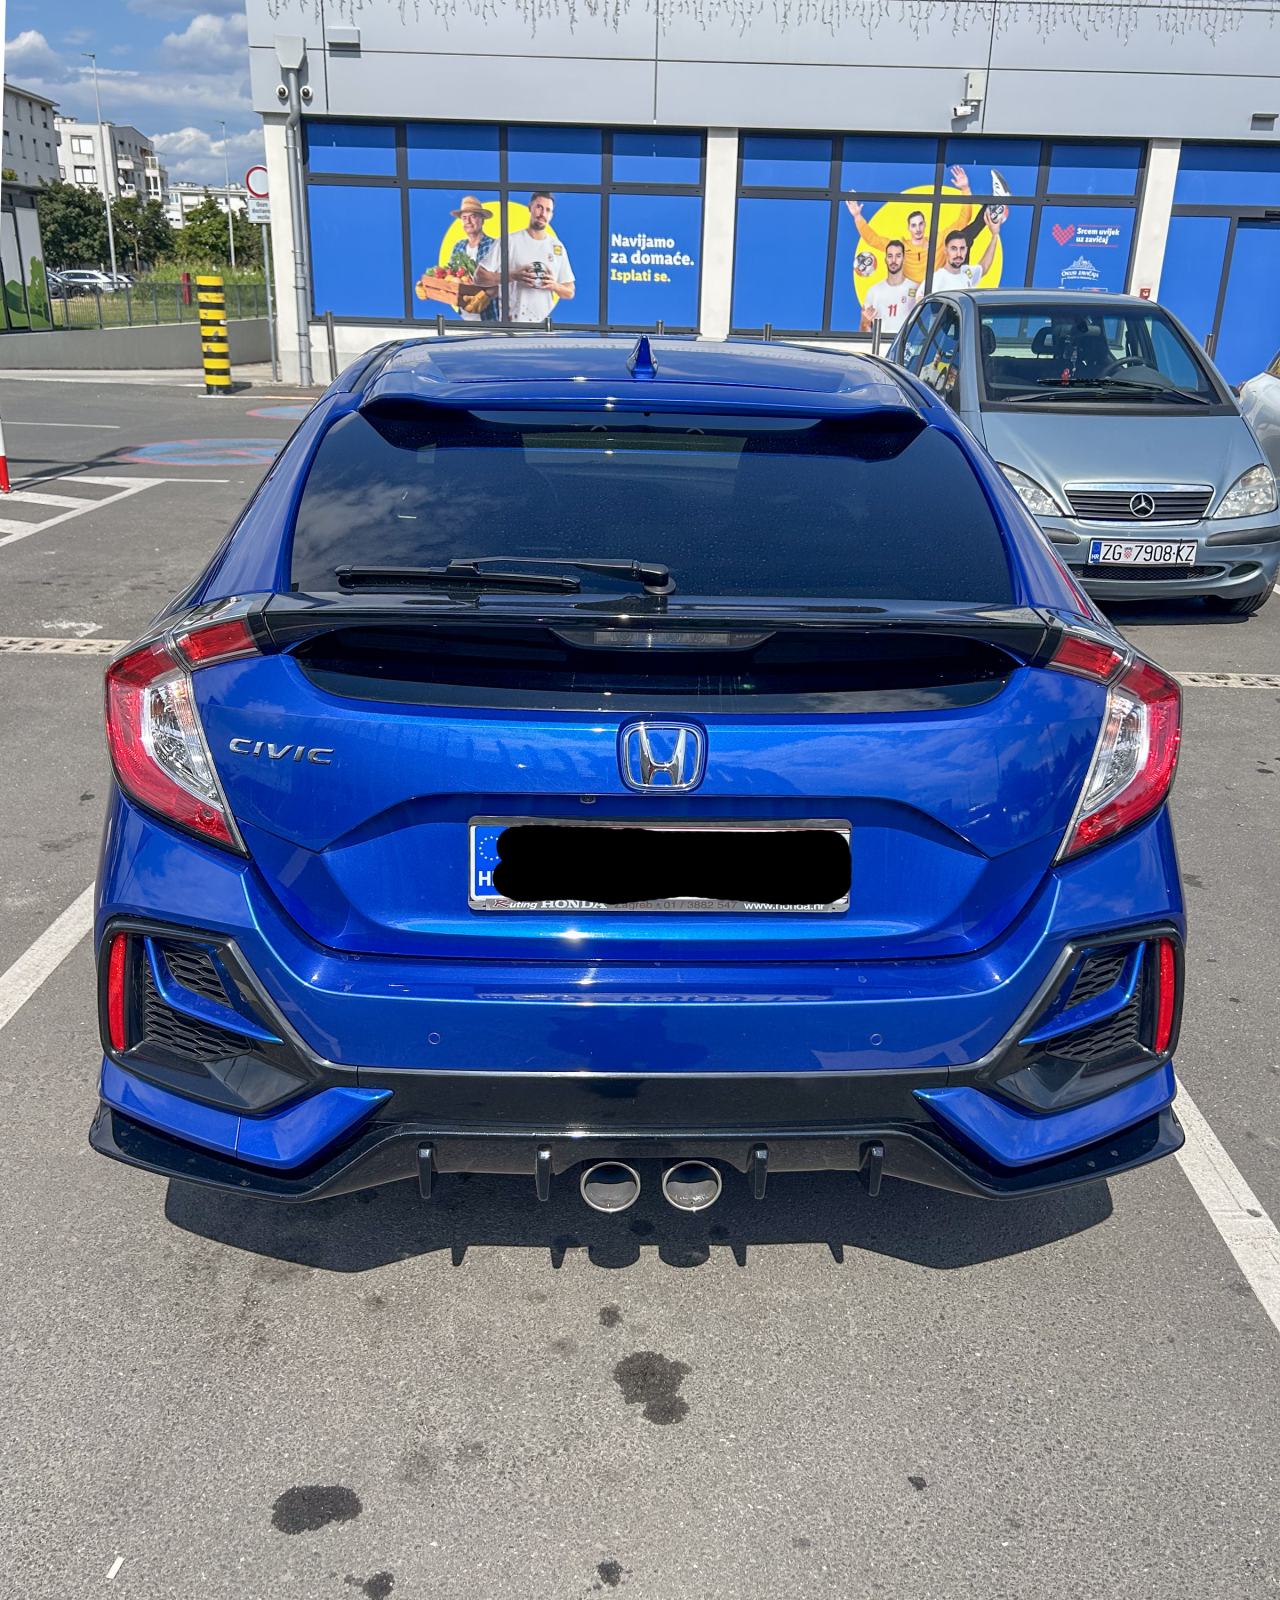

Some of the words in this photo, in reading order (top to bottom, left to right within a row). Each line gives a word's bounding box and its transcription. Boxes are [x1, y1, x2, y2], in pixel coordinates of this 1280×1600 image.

[611, 233, 675, 250] Navijamo
[610, 252, 628, 264] za
[630, 250, 695, 266] domaće.
[610, 269, 651, 283] Isplati
[653, 272, 671, 282] se.
[887, 304, 897, 317] 11
[1102, 544, 1122, 561] ZG
[229, 738, 334, 765] CIVIC
[478, 870, 495, 887] H
